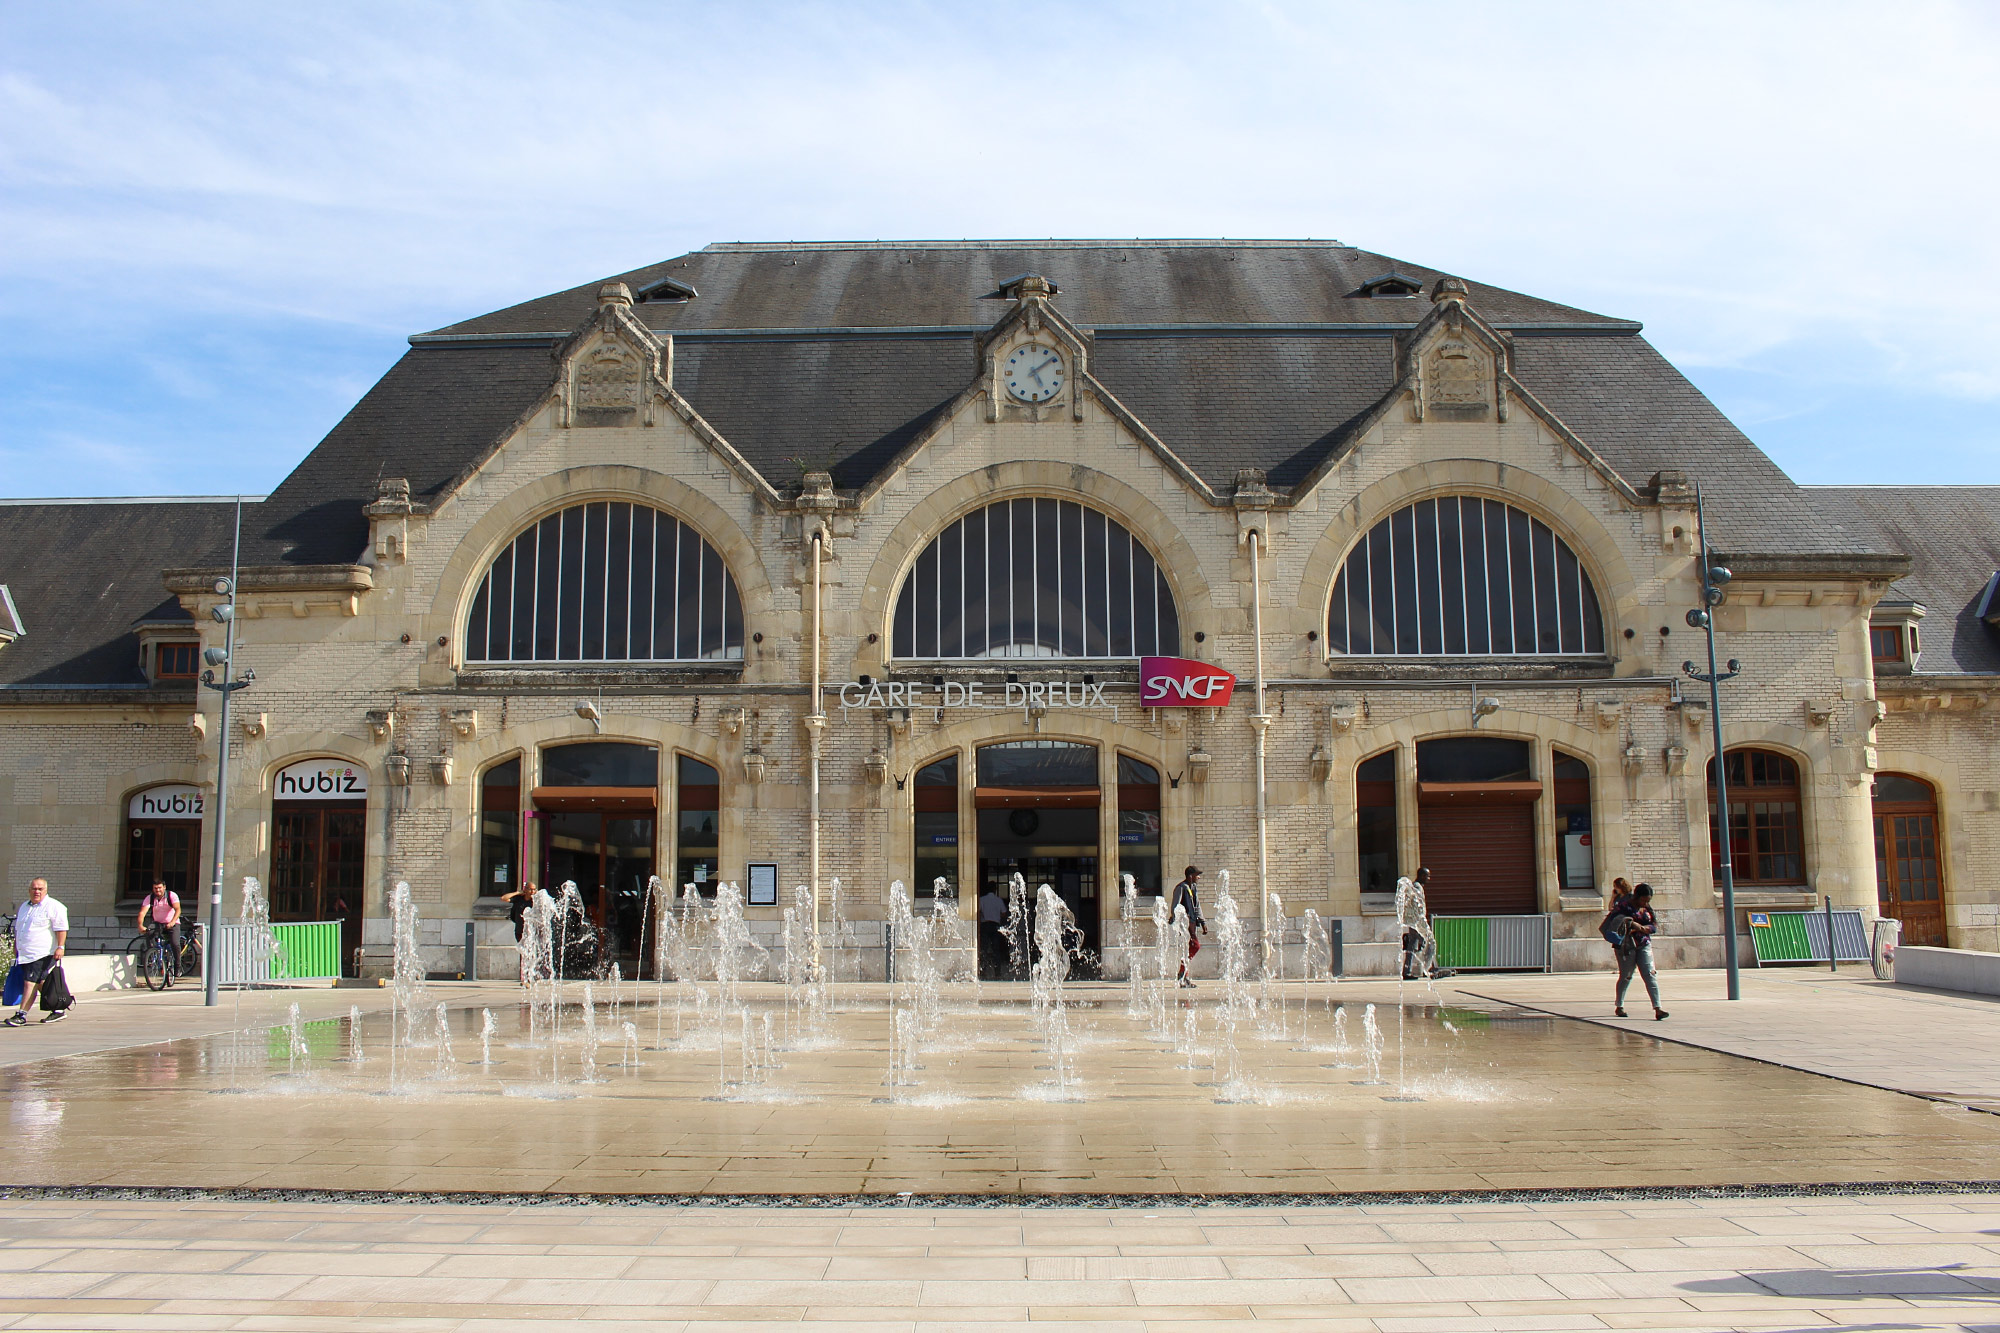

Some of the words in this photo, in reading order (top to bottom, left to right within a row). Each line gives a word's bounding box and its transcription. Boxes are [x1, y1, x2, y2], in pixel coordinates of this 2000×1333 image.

[839, 681, 922, 708] GARE
[944, 681, 983, 707] DE
[1005, 681, 1108, 707] DREUX
[1143, 675, 1230, 700] SNCF
[280, 771, 366, 793] hubiz
[142, 795, 203, 813] hubiz
